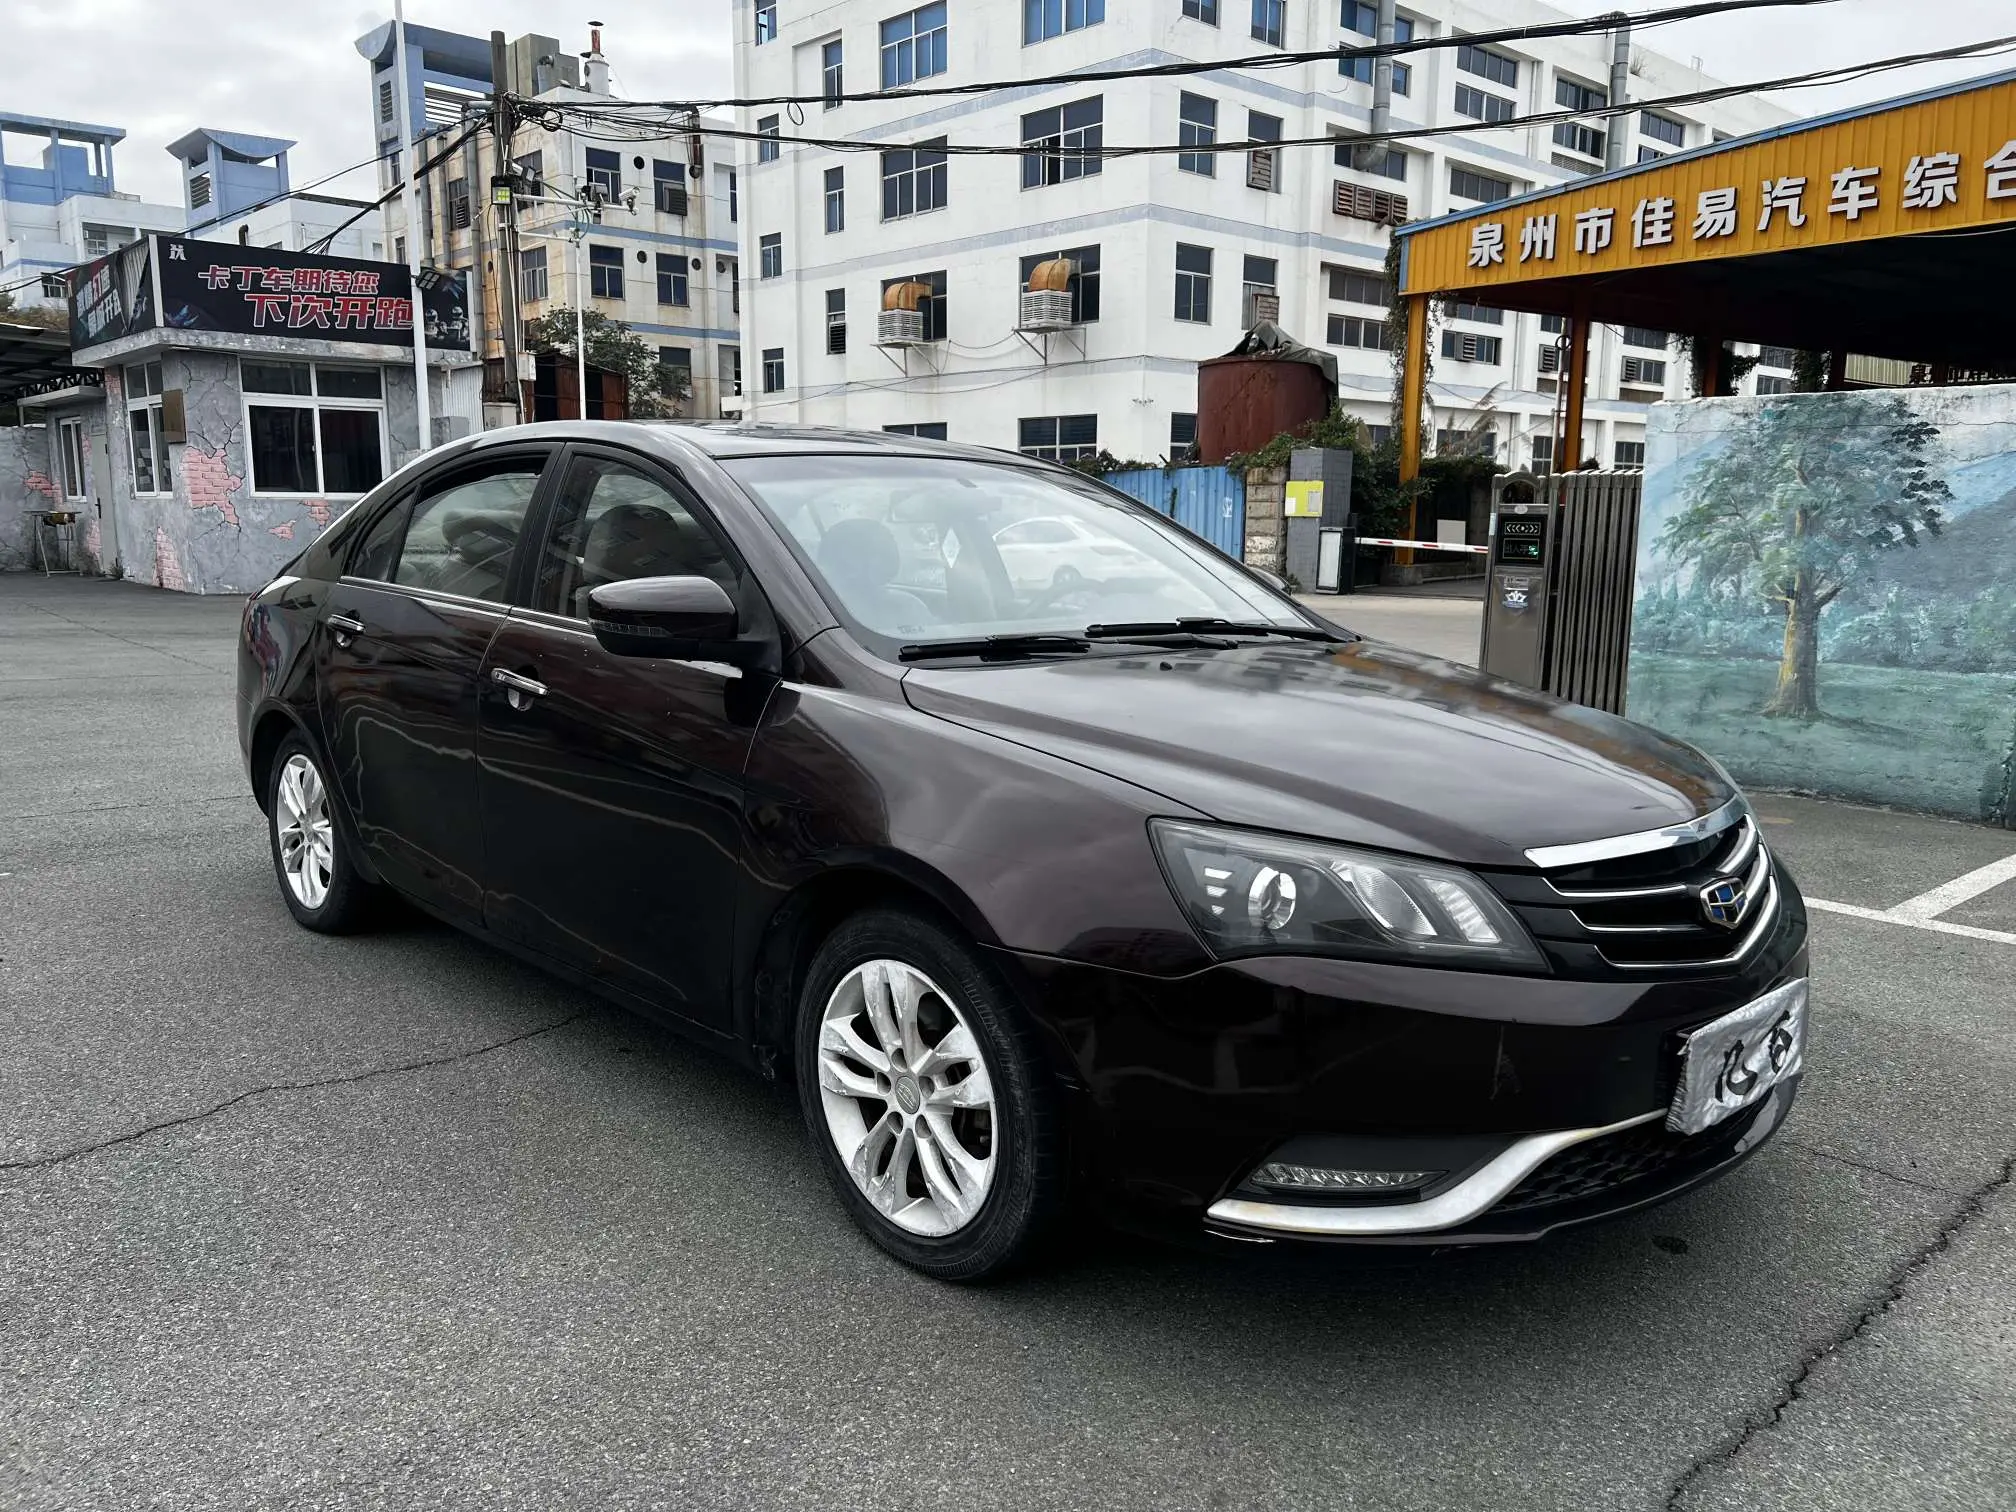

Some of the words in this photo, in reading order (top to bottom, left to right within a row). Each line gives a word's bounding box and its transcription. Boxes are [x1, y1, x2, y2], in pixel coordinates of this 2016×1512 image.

[198, 264, 380, 294] 卡丁车期待您
[244, 293, 413, 329] 下次开跑
